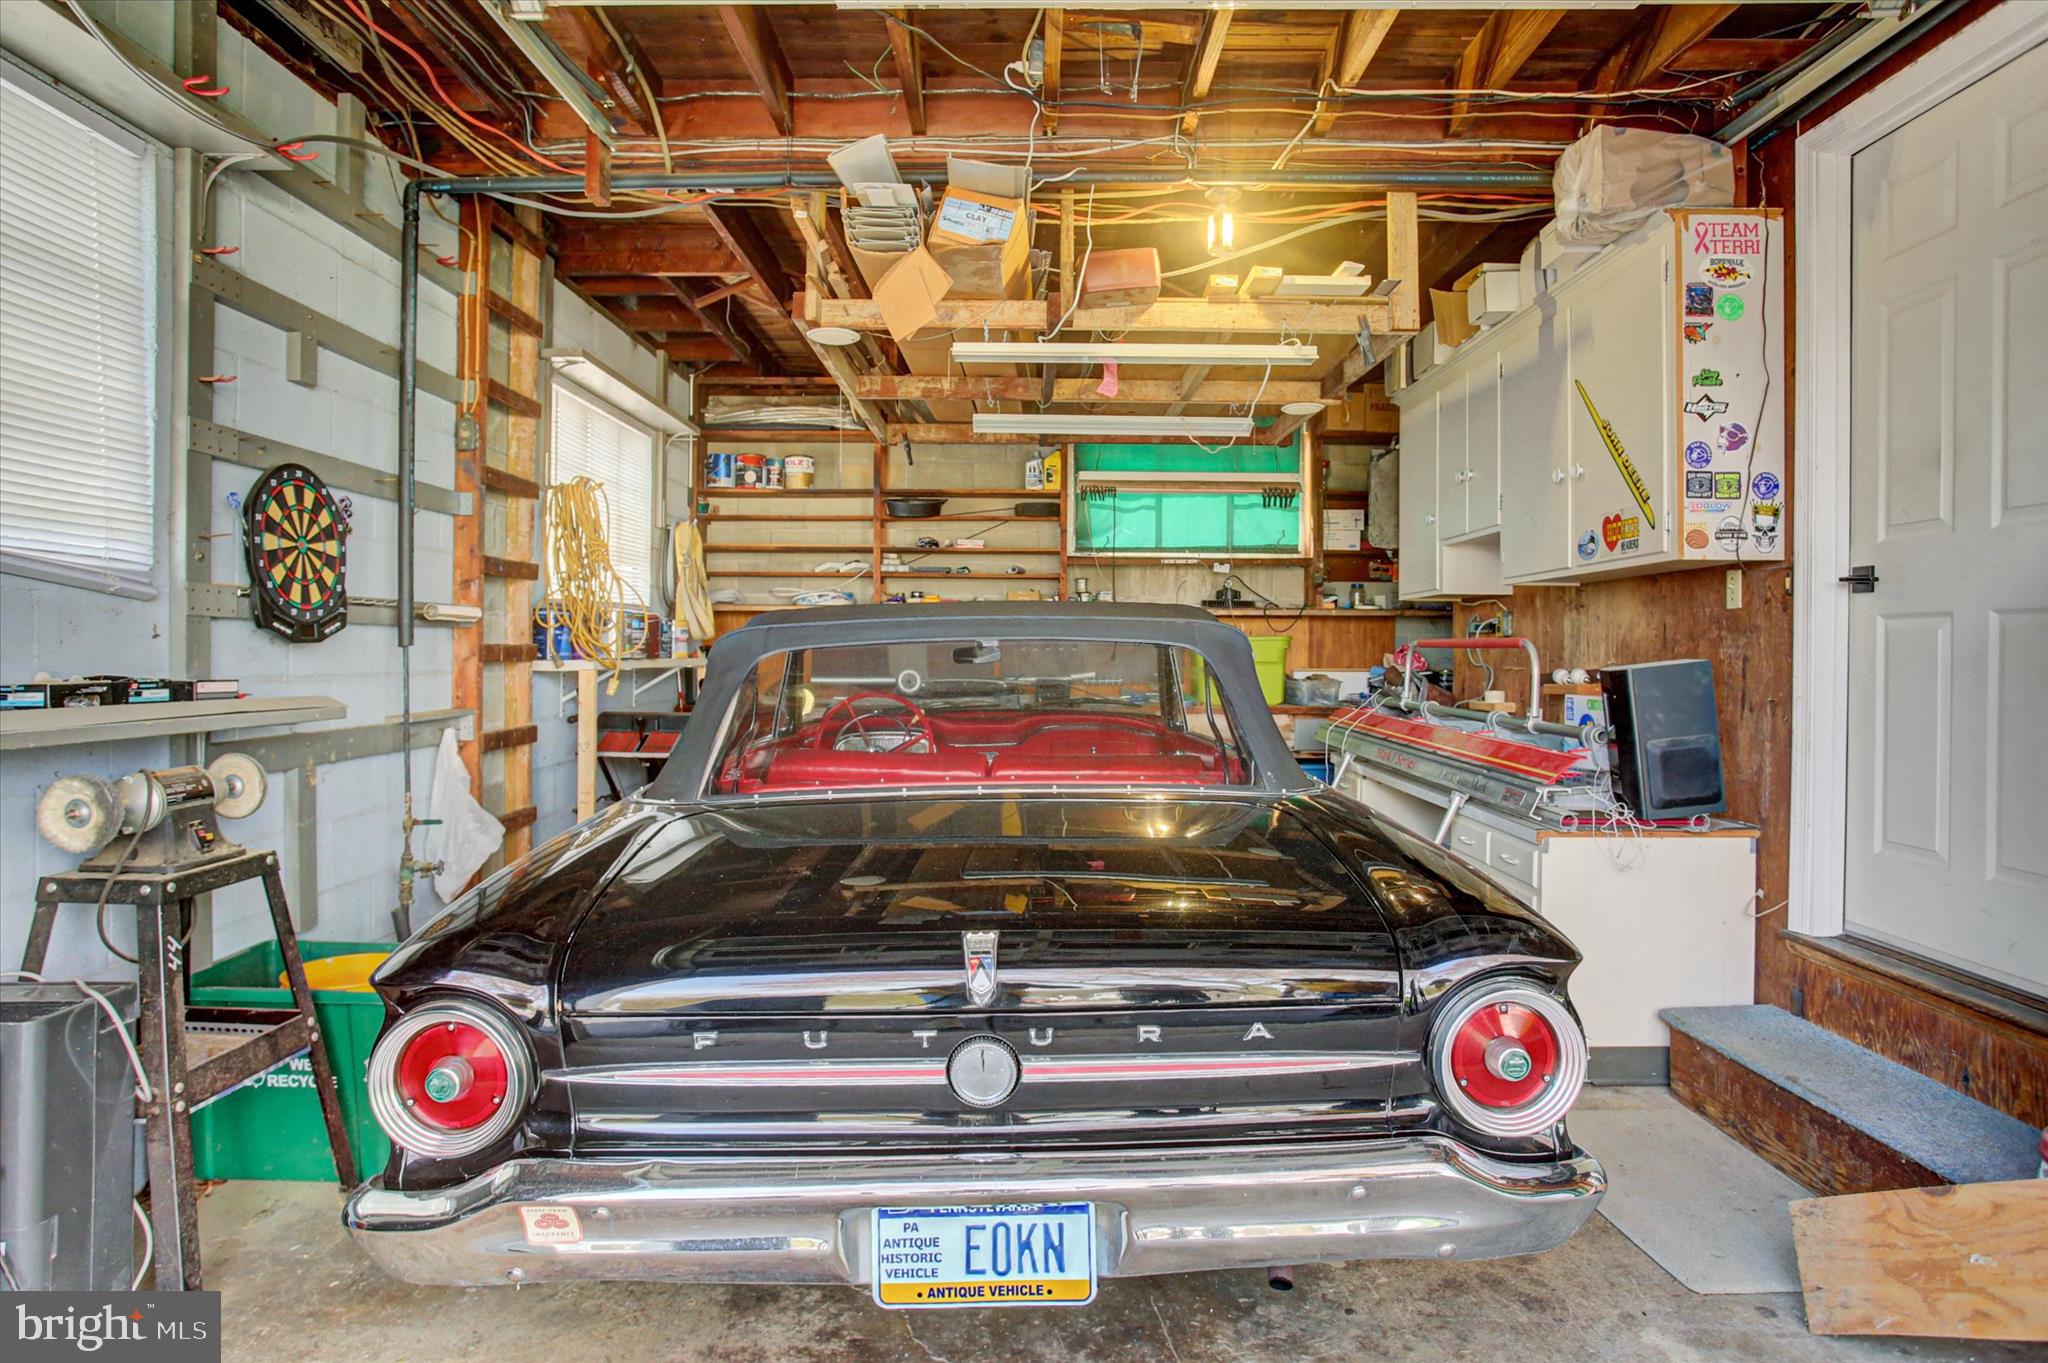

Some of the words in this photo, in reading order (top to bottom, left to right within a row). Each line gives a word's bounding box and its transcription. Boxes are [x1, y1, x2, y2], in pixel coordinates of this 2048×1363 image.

[965, 211, 988, 224] CLAY
[1708, 222, 1760, 238] TEAM
[1709, 239, 1760, 255] TERRI
[1602, 418, 1625, 458] JOHN
[1622, 455, 1651, 504] DEERE
[289, 1058, 312, 1071] WE
[266, 1074, 338, 1088] RECYCE
[902, 1222, 919, 1233] PA
[882, 1236, 941, 1250] ANTIQUE
[881, 1252, 943, 1265] HISTORIC
[885, 1267, 939, 1279] VEHICLE
[927, 1285, 985, 1299] ANTIQUE
[989, 1284, 1044, 1297] VEHICLE
